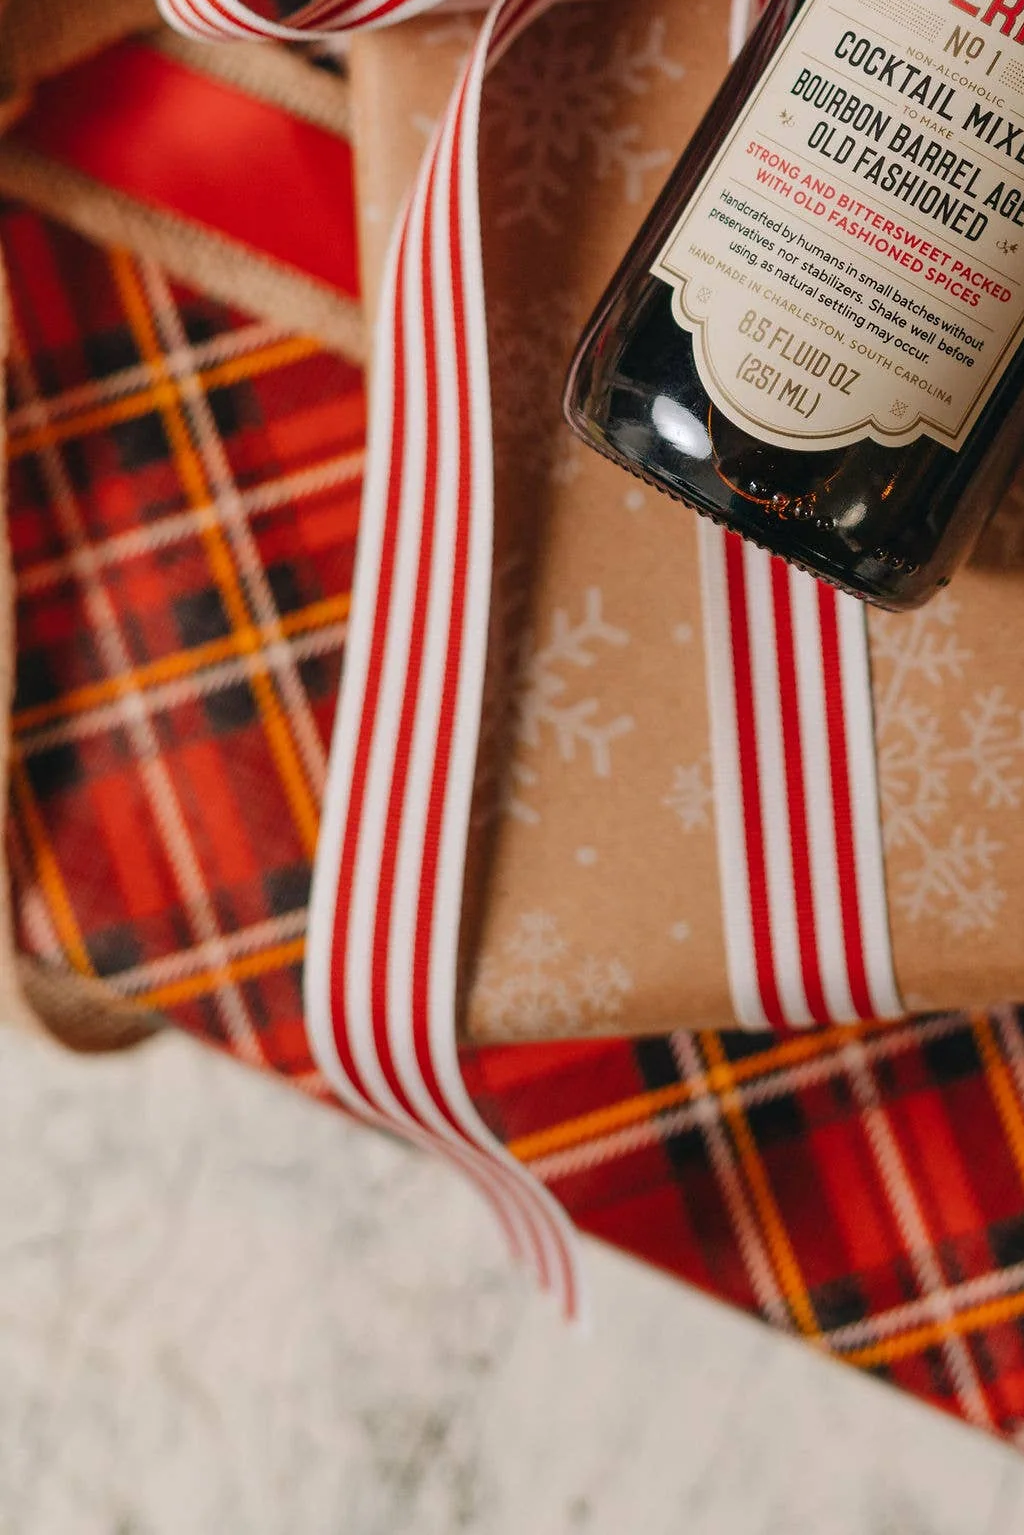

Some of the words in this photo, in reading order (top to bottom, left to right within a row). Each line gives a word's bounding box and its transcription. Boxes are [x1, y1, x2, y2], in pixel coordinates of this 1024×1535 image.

[834, 30, 956, 122] COCKTAIL
[902, 104, 919, 120] TO
[919, 115, 955, 141] MAKE
[906, 46, 1006, 109] NON-ALCOHOLIC
[985, 50, 1003, 77] 1
[790, 67, 893, 143] BOURBON
[886, 122, 982, 200] BARREL
[807, 120, 856, 165] OLD
[851, 145, 989, 242] FASHIONED
[719, 189, 784, 234] Handcrafted
[780, 224, 798, 244] by
[795, 234, 846, 271] humans
[844, 262, 858, 279] in
[857, 273, 894, 298] small
[891, 289, 941, 326] batches
[940, 320, 985, 352] without
[745, 141, 801, 180] STRONG
[800, 174, 836, 200] AND
[836, 193, 952, 267] BITTERSWEET
[950, 259, 1012, 303] PACKED
[756, 167, 794, 198] WITH
[793, 190, 827, 216] OLD
[827, 209, 924, 273] FASHIONED
[924, 267, 982, 307] SPICES
[688, 244, 716, 266] HAND
[715, 260, 748, 285] MADE
[747, 279, 763, 294] IN
[763, 289, 846, 345] CHARLESTON,
[848, 339, 894, 370] SOUTH
[893, 365, 952, 406] CAROLINA
[708, 207, 776, 252] preservatives
[776, 247, 800, 265] nor
[800, 261, 864, 305] stabilizers.
[868, 298, 908, 329] Shake
[910, 324, 937, 345] well
[936, 338, 975, 368] before
[729, 241, 759, 266] using,
[760, 259, 775, 273] as
[773, 267, 820, 299] natural
[817, 293, 867, 329] settling
[865, 321, 895, 344] may
[893, 337, 930, 365] occur.
[735, 352, 782, 396] (251
[777, 378, 822, 419] ML)
[737, 309, 773, 343] 8.5
[767, 326, 832, 378] FLUID
[828, 362, 861, 396] OZ
